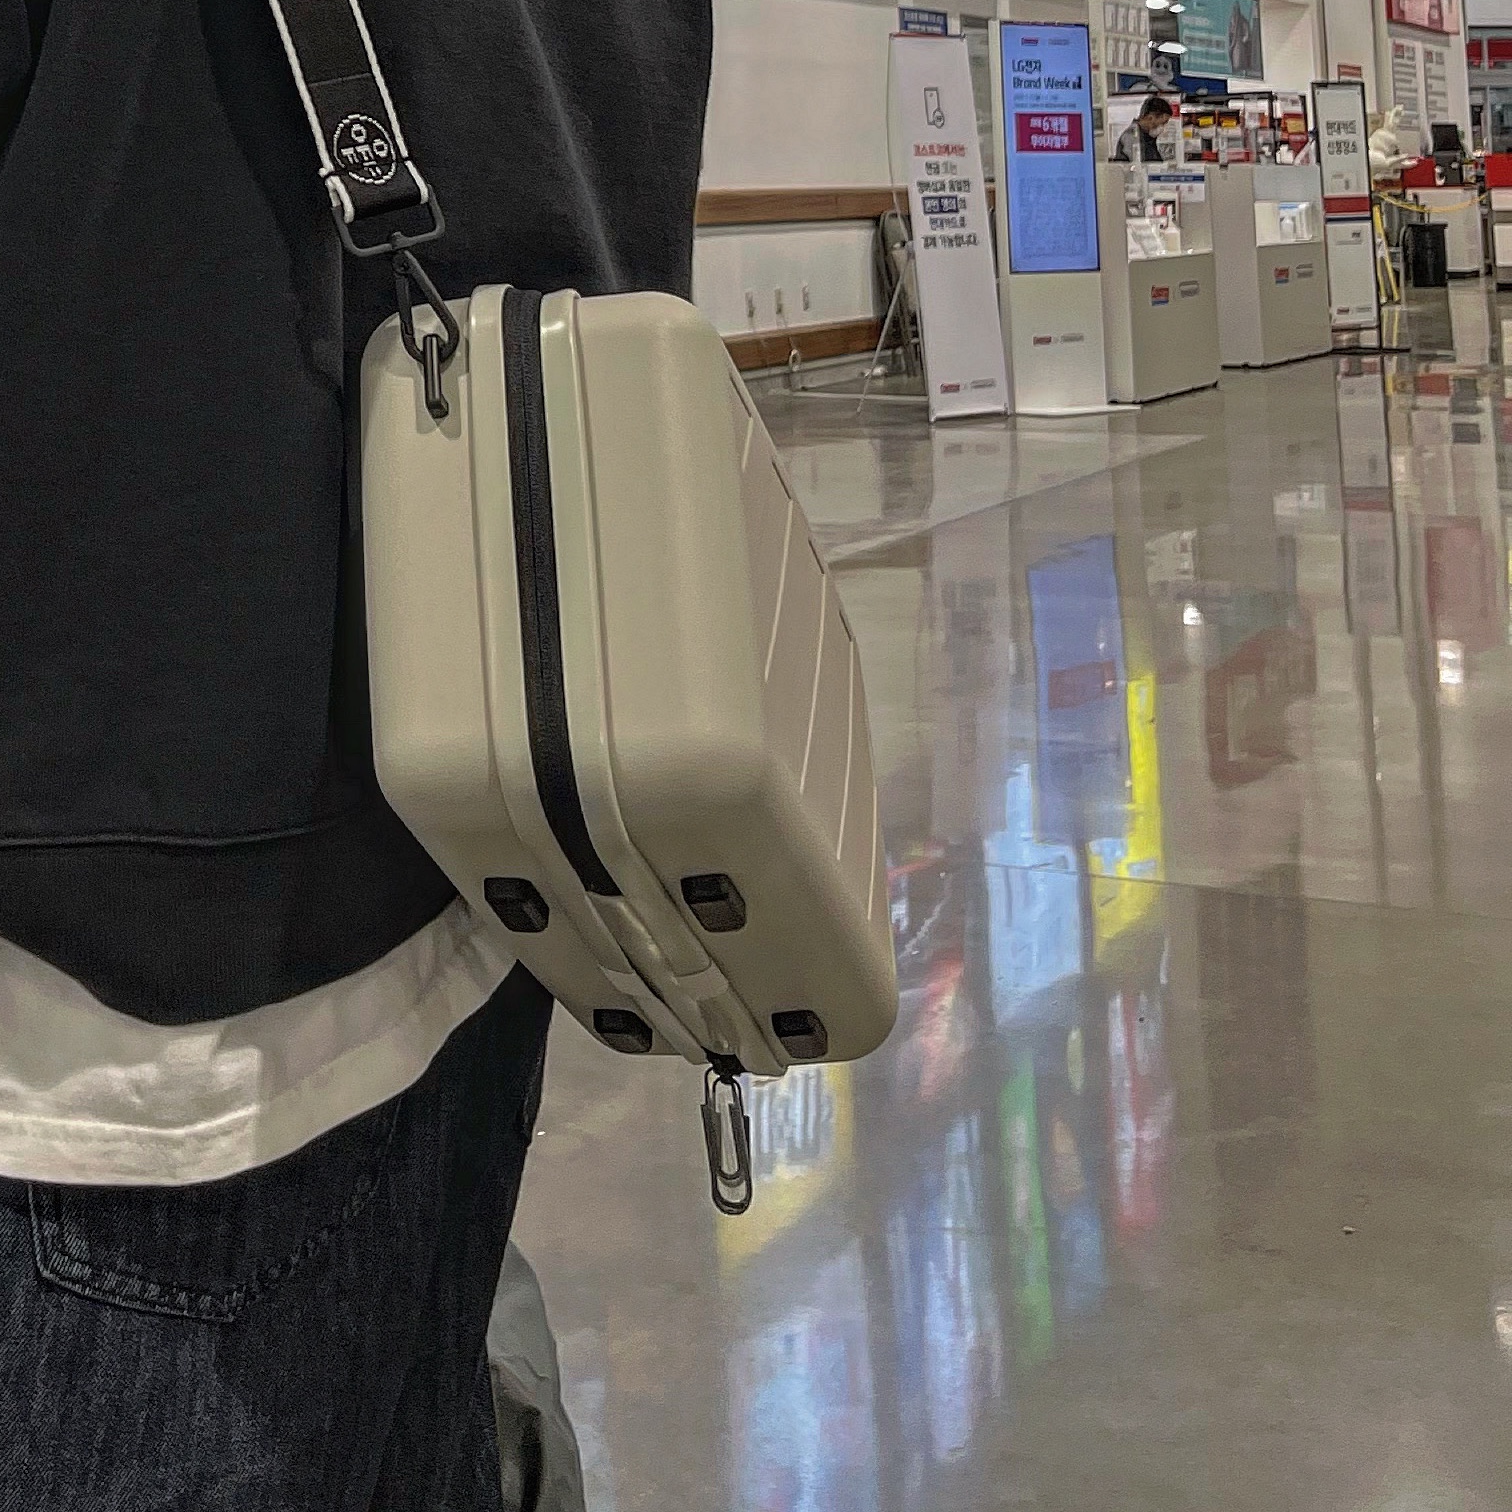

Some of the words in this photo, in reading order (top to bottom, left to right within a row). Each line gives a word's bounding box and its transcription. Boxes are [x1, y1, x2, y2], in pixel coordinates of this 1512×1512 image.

[1012, 59, 1042, 74] LG전자
[1013, 76, 1041, 89] Brand
[1044, 76, 1070, 89] Week
